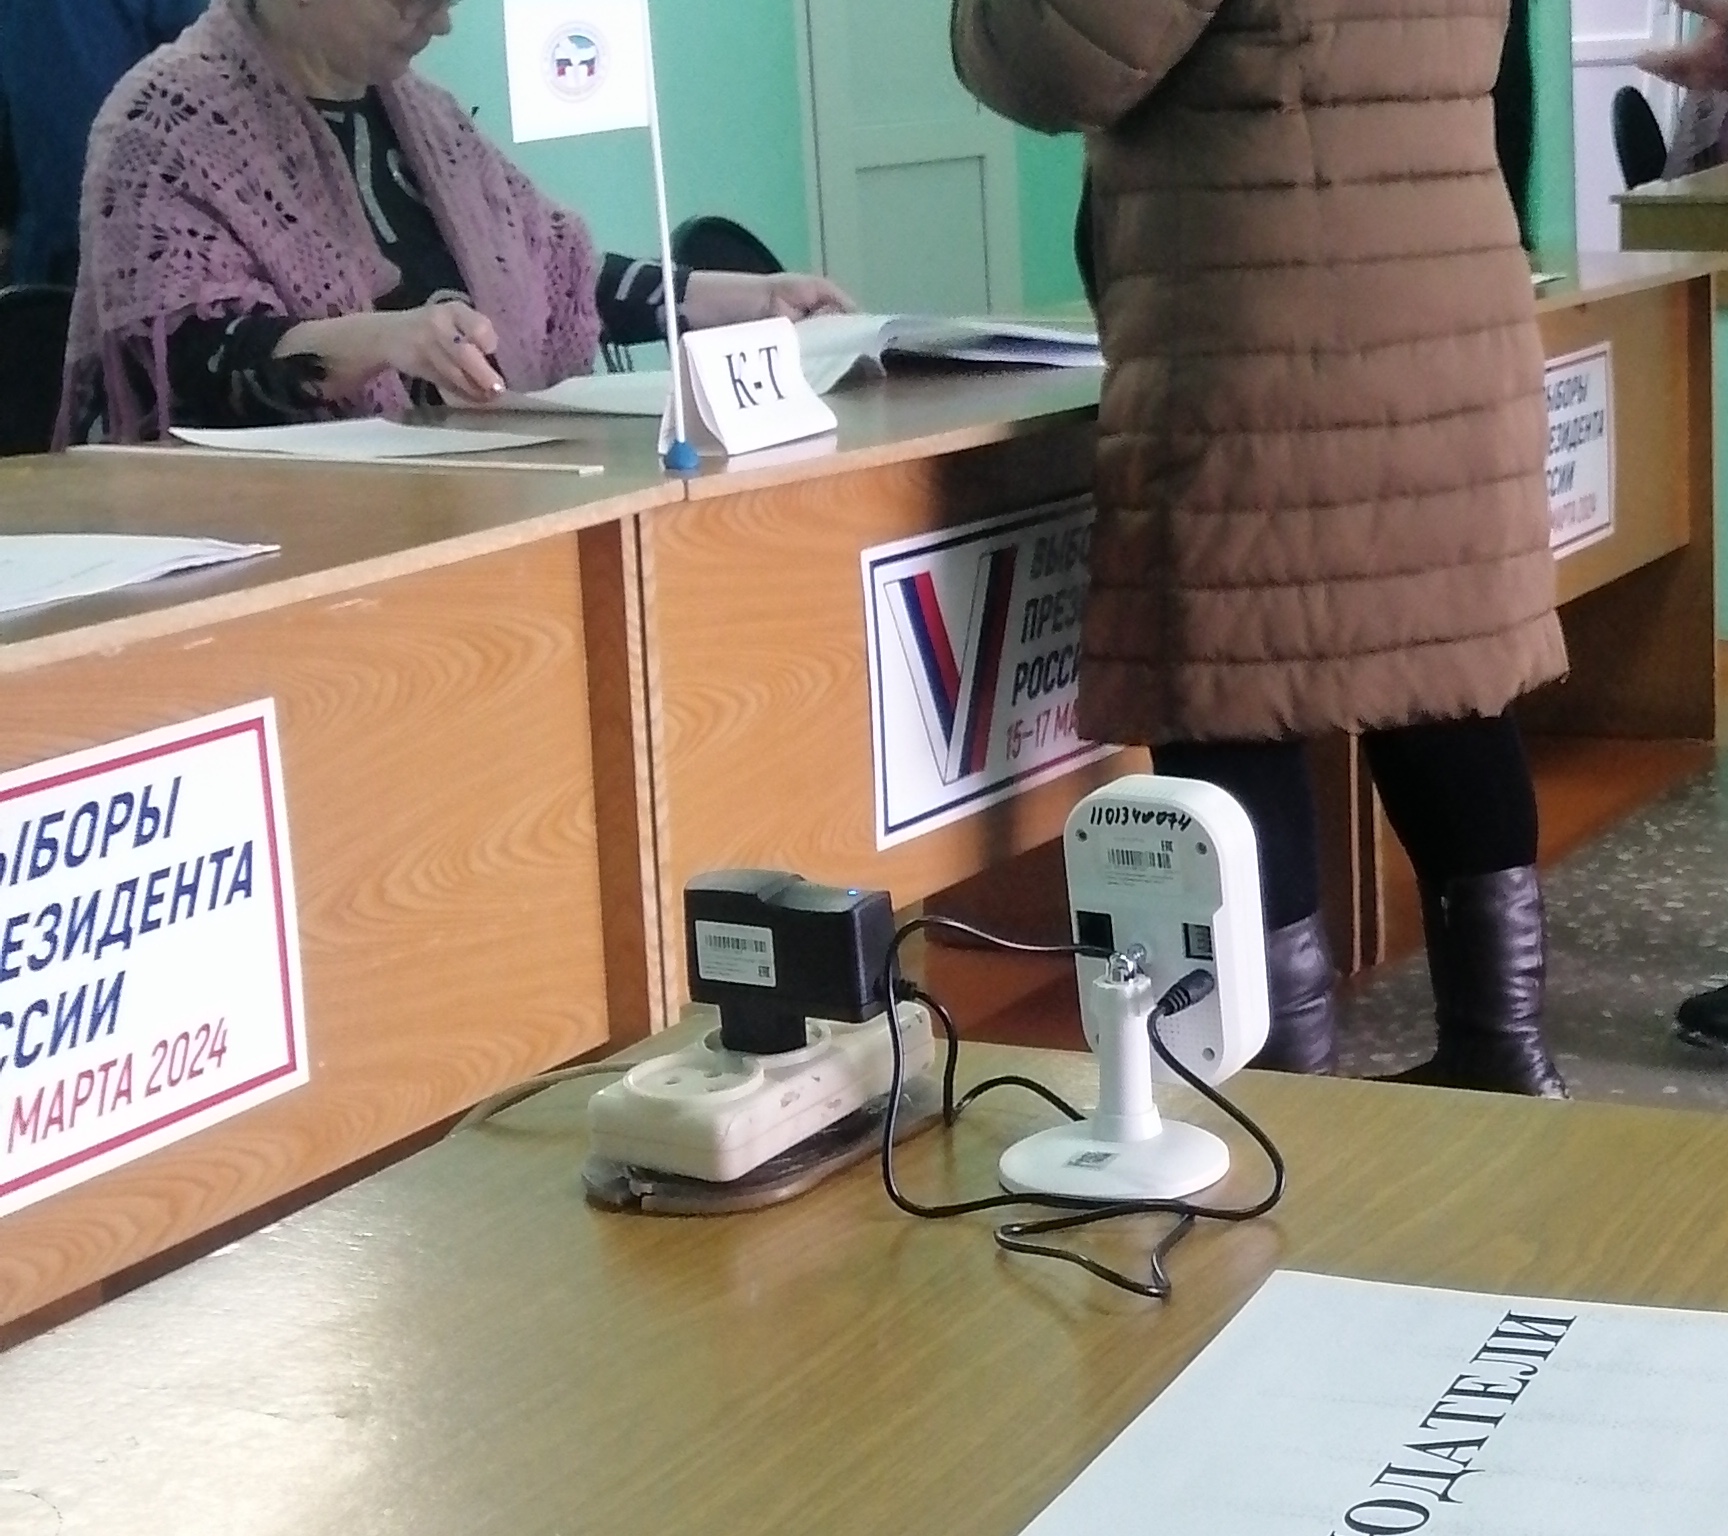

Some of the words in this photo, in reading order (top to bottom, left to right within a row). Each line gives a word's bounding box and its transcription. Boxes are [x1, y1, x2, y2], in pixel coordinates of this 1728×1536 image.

[725, 345, 789, 411] К-Т
[0, 840, 254, 983] ЕЗИДЕНТА
[5, 1052, 134, 1154] МАРТА
[143, 1017, 229, 1101] 2024
